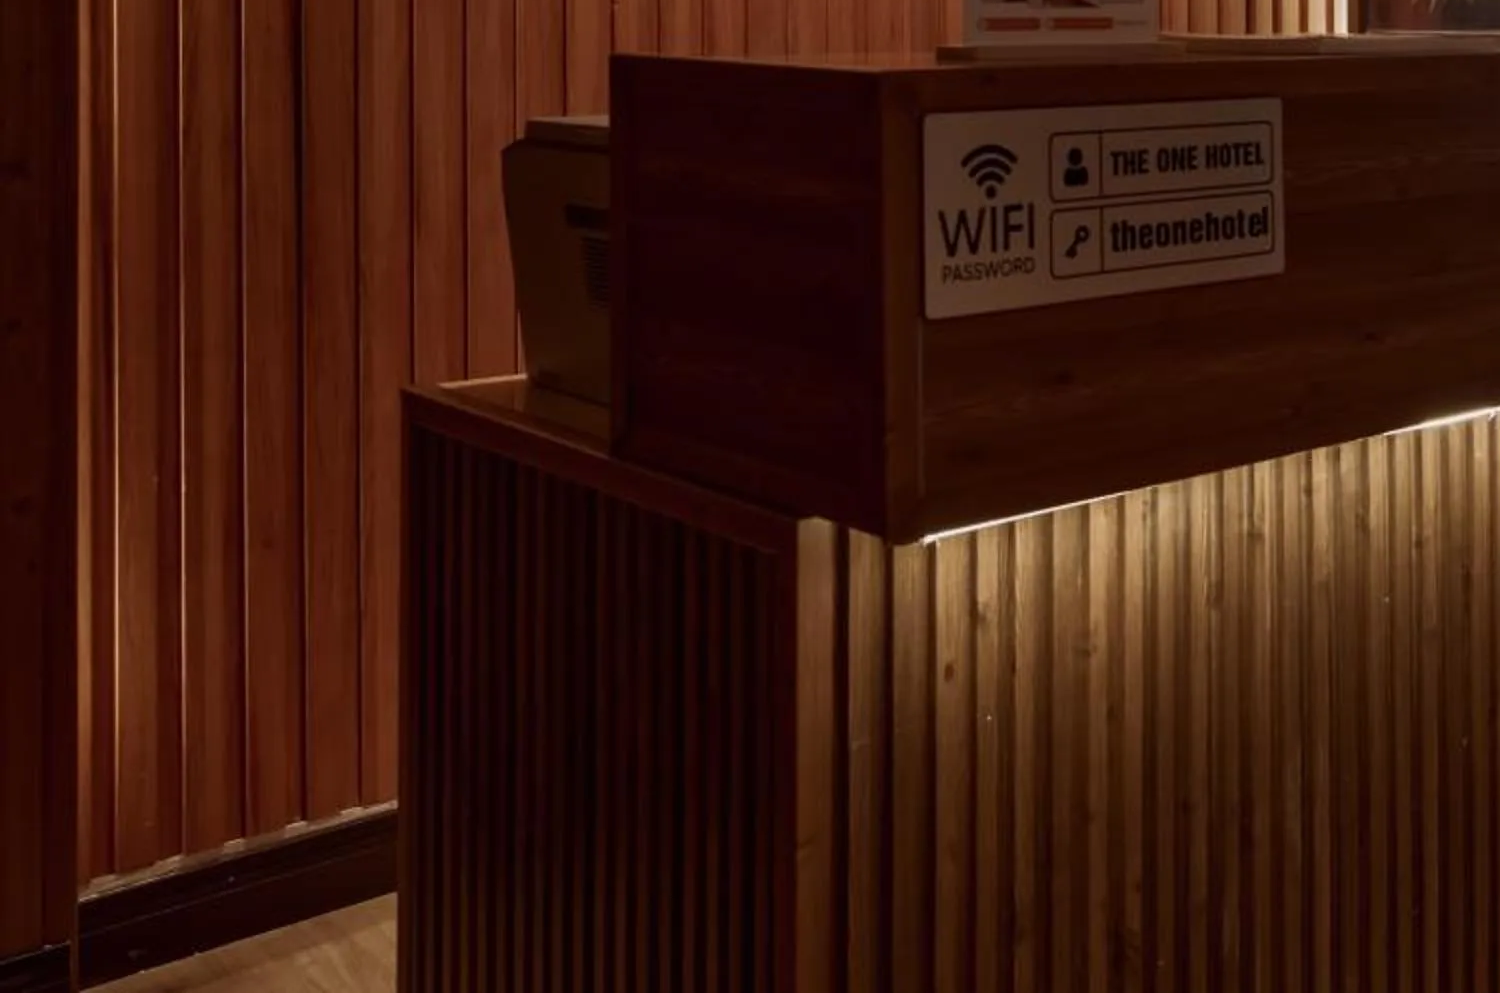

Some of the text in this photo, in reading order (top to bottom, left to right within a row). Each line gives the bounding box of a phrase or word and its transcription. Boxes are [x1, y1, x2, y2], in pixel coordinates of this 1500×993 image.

[1110, 141, 1265, 176] THE ONE HOTEL
[938, 203, 1035, 258] WIFI
[1110, 206, 1269, 253] theonehotel
[942, 256, 1036, 284] PASSWORD
